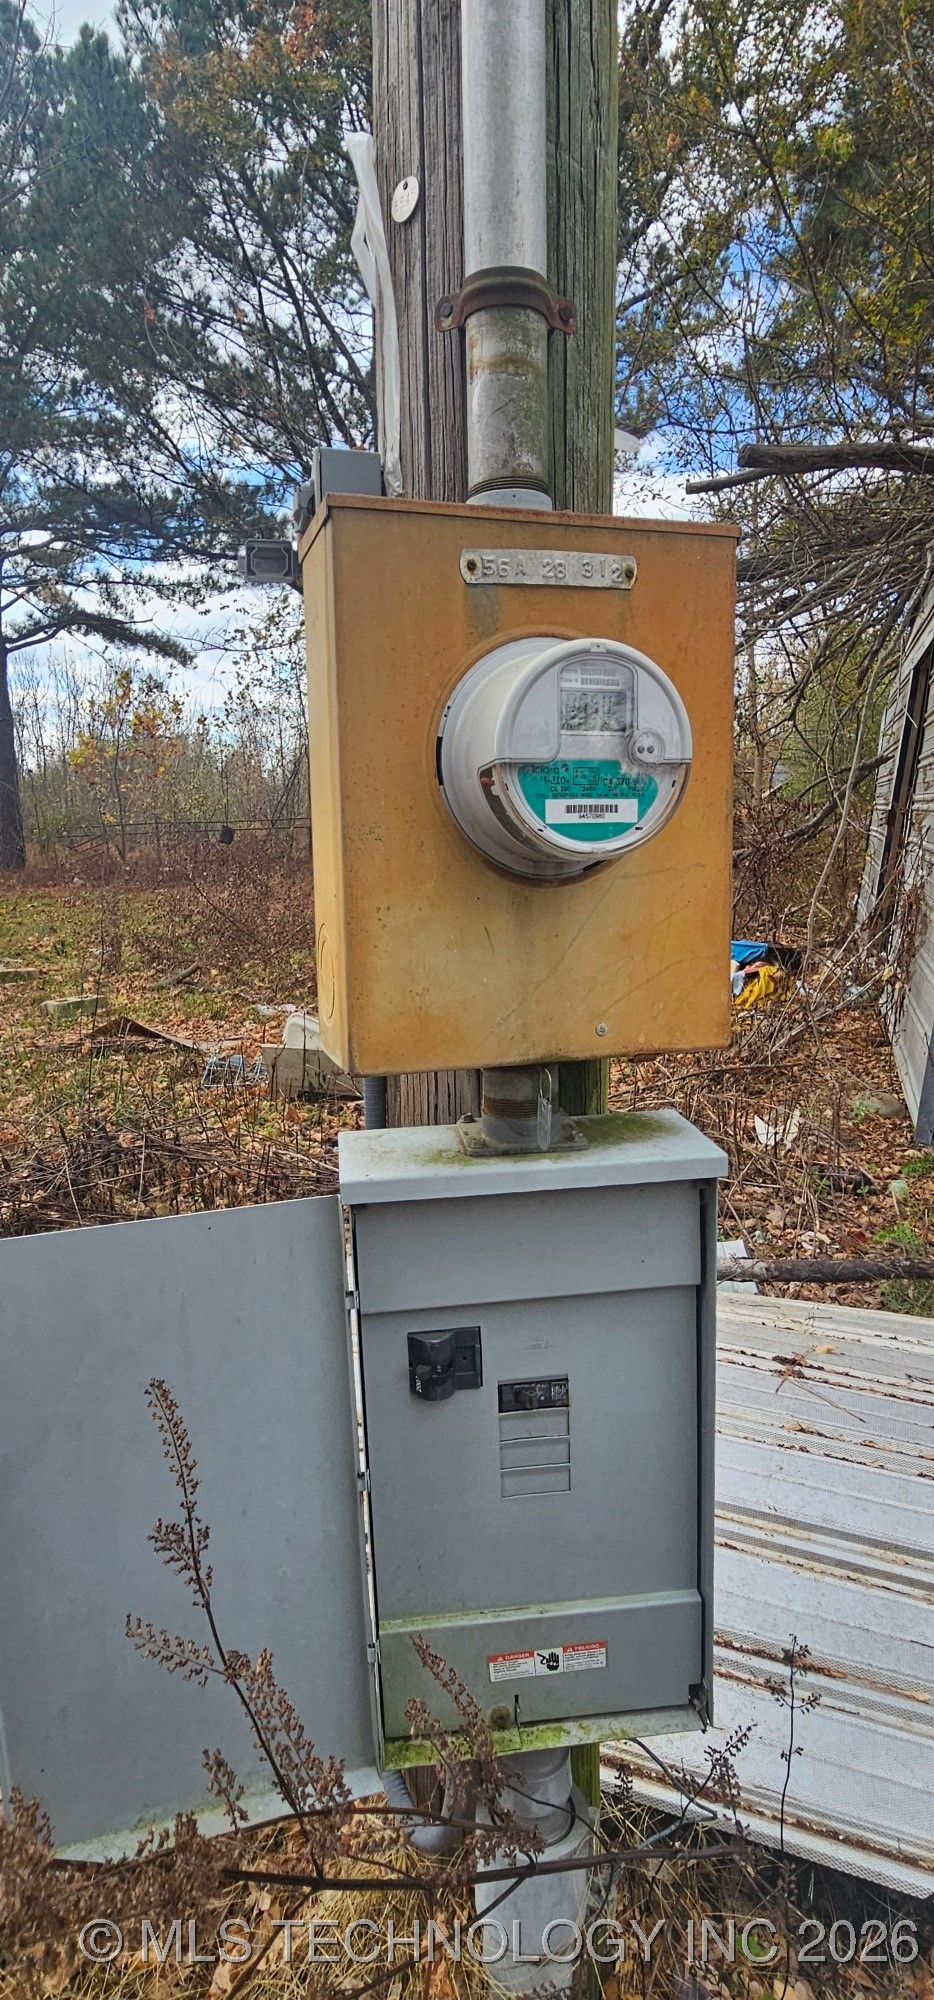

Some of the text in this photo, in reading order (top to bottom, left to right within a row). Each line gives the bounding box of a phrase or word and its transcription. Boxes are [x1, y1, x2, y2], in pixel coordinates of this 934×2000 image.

[481, 555, 529, 578] 56A
[541, 558, 567, 579] 28
[574, 1643, 600, 1651] PELIGRO
[505, 1652, 530, 1660] DANGER
